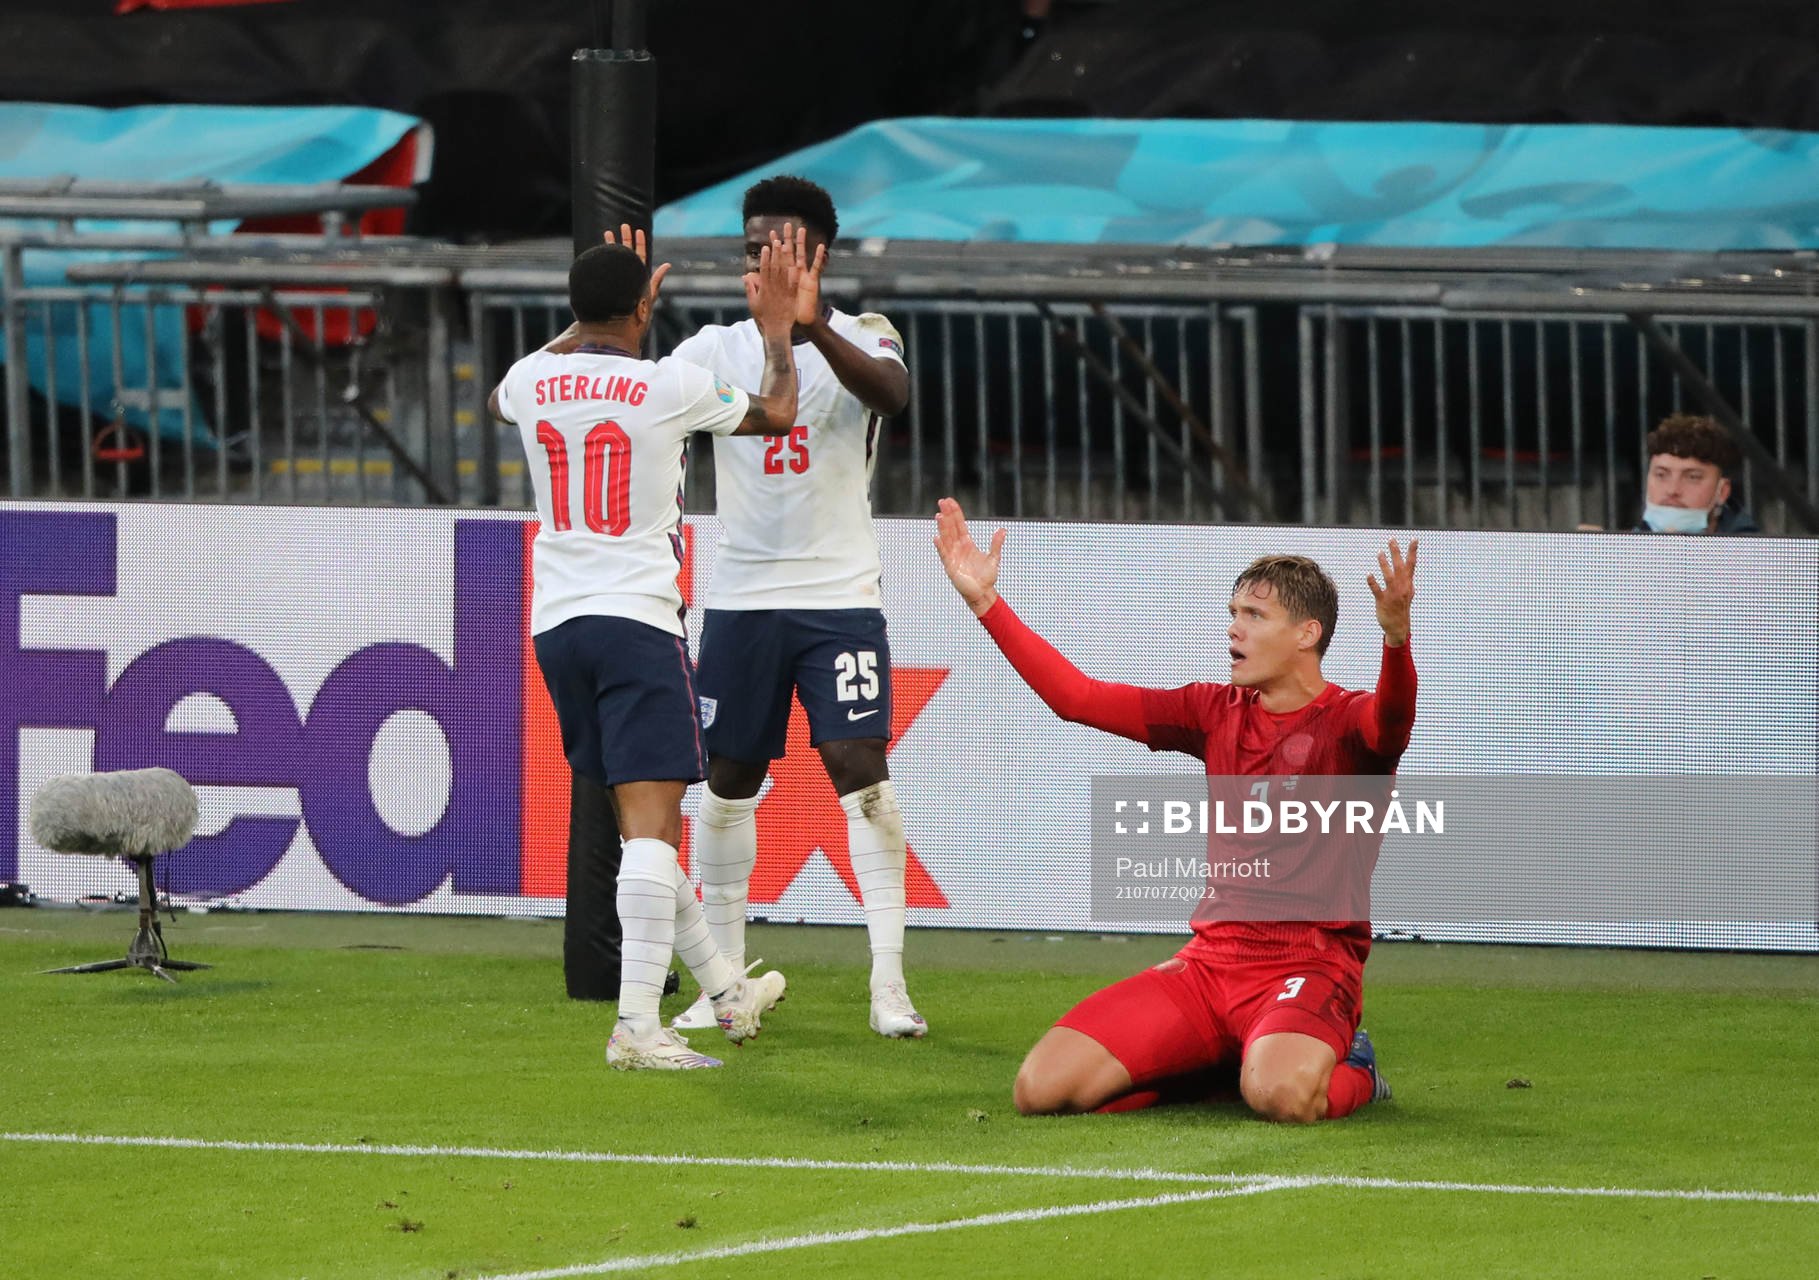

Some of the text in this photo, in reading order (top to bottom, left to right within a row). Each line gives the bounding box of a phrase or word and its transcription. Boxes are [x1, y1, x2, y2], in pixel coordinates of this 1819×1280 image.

[535, 374, 648, 406] STERLING
[763, 425, 810, 475] 25
[536, 419, 632, 537] 10
[834, 651, 879, 702] 25
[0, 510, 951, 909] Fedx
[1277, 977, 1306, 1001] 3
